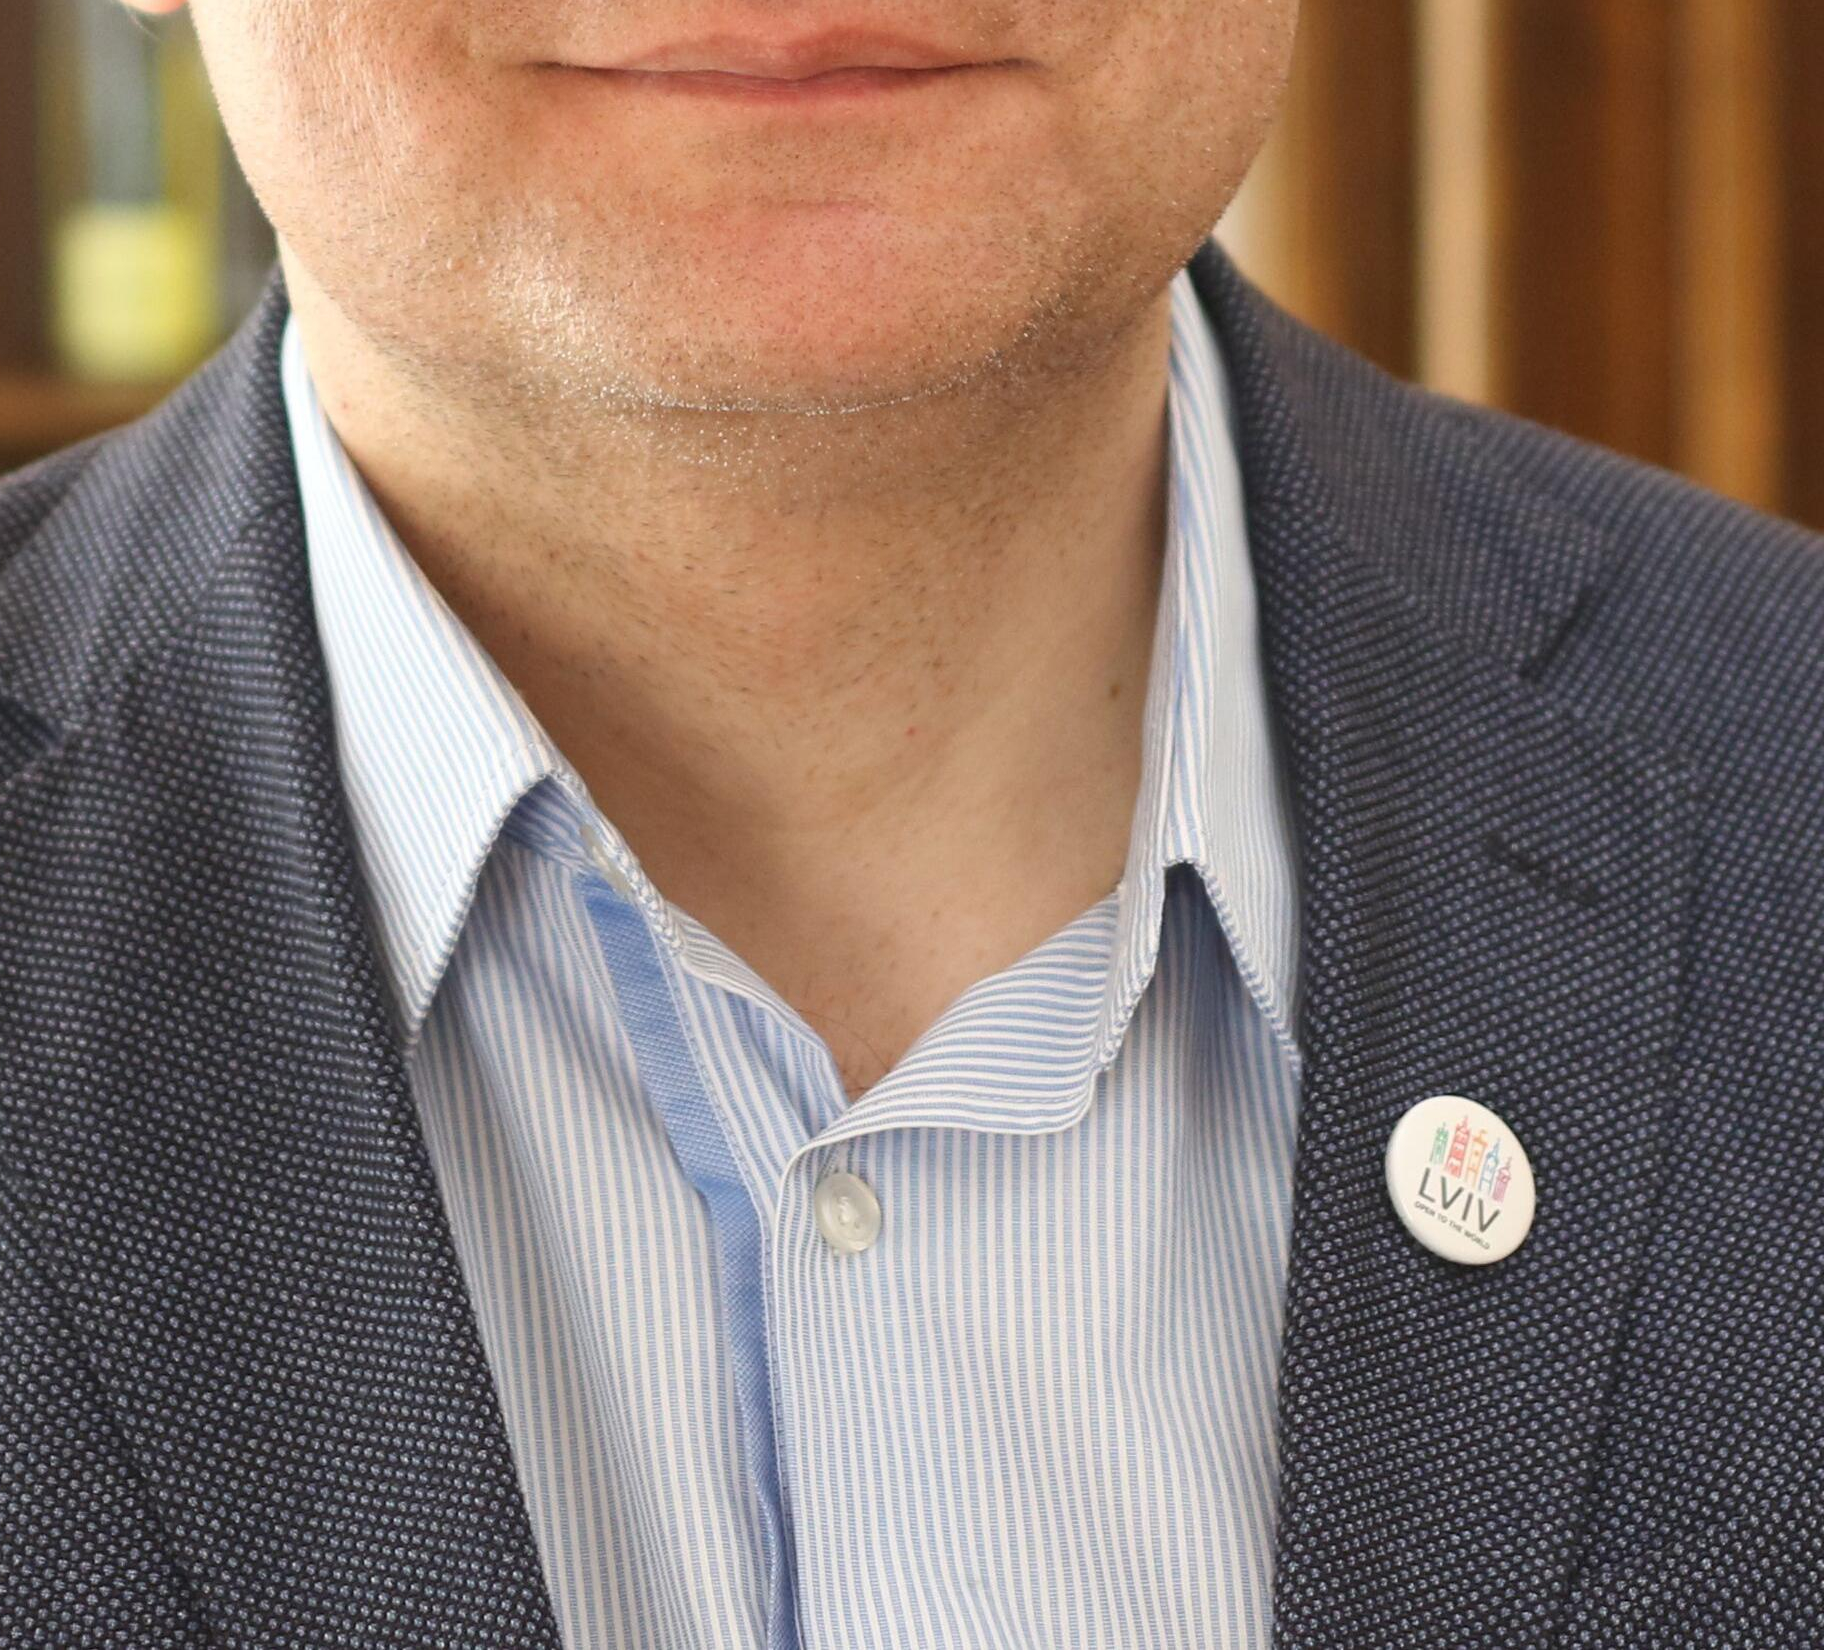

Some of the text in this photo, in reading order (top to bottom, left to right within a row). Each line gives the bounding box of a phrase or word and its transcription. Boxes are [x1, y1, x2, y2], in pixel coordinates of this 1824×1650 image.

[1414, 1201, 1490, 1250] OPEN TO THE WORLD
[1418, 1167, 1501, 1233] LVIV
